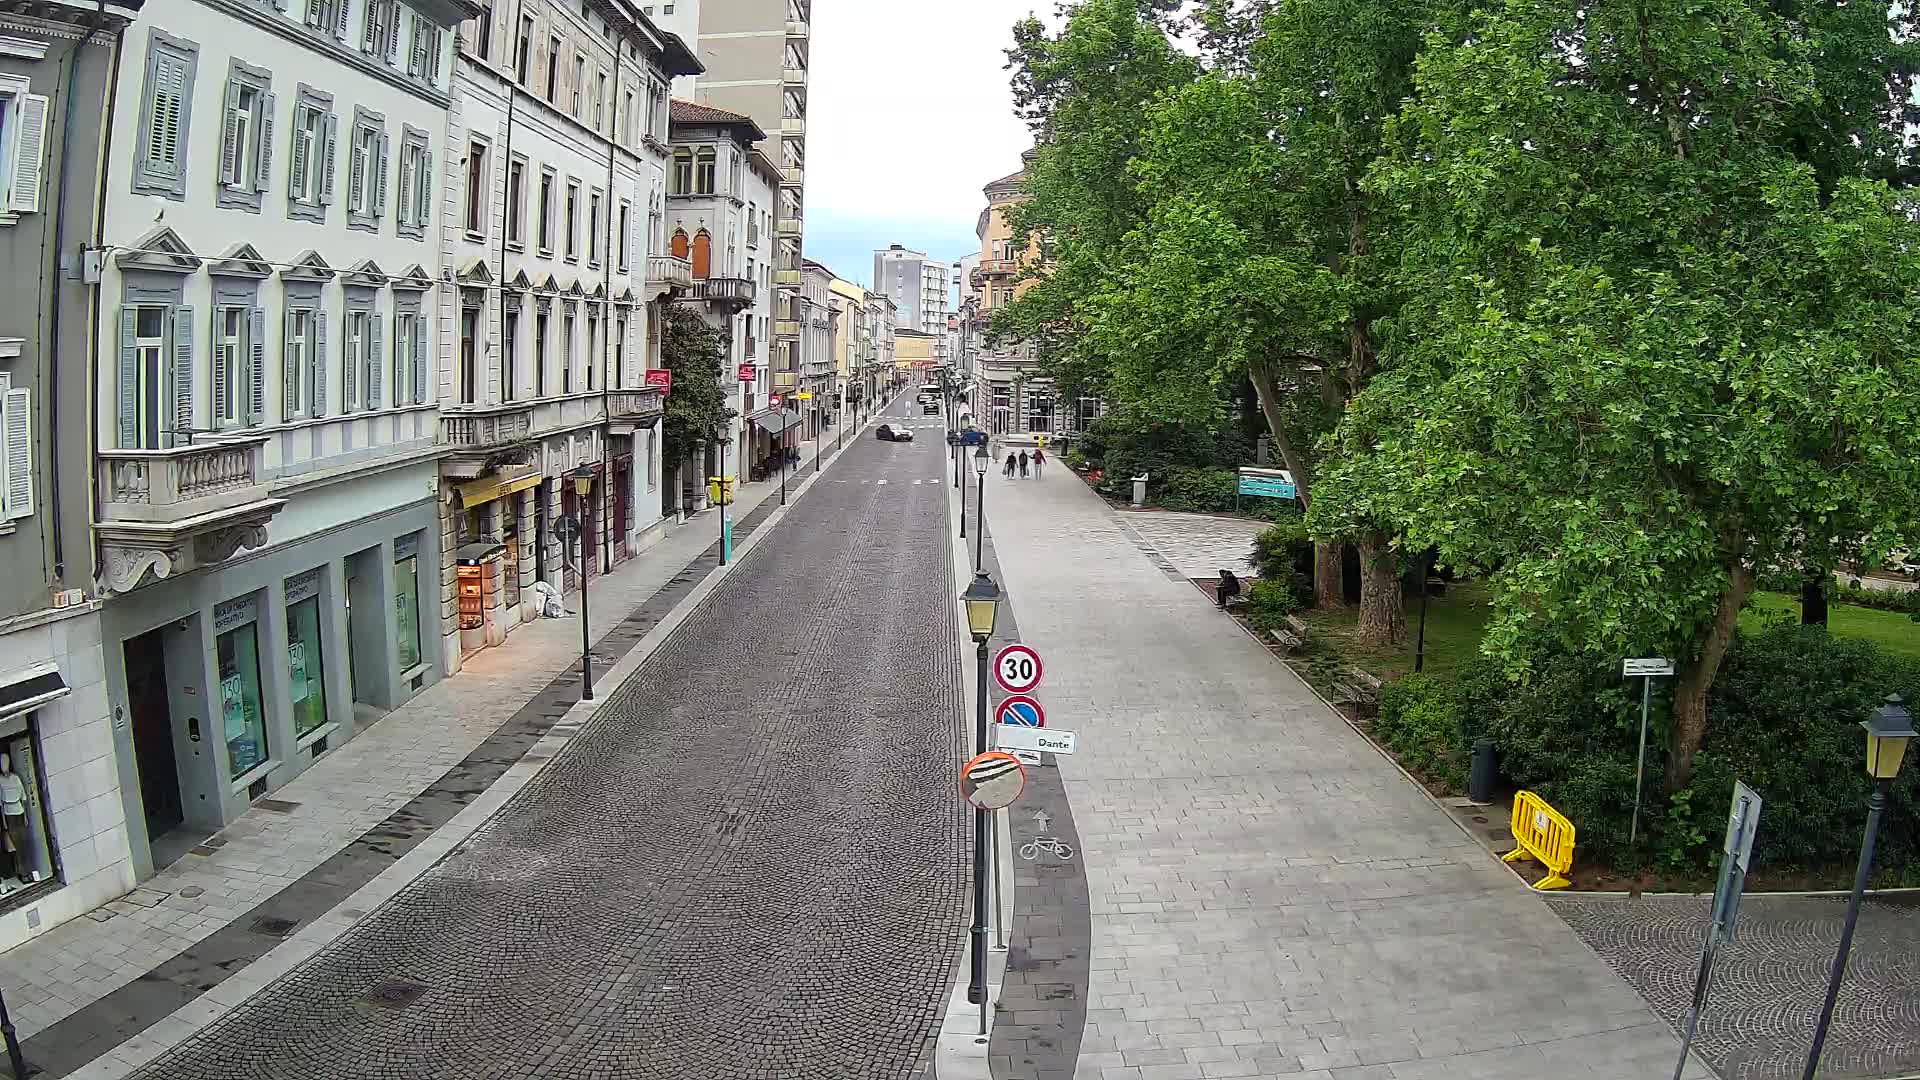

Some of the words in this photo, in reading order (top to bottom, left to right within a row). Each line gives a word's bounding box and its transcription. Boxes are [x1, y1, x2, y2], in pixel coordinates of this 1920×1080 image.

[1005, 658, 1033, 680] 30
[222, 677, 240, 700] 130
[1038, 738, 1070, 749] Dante
